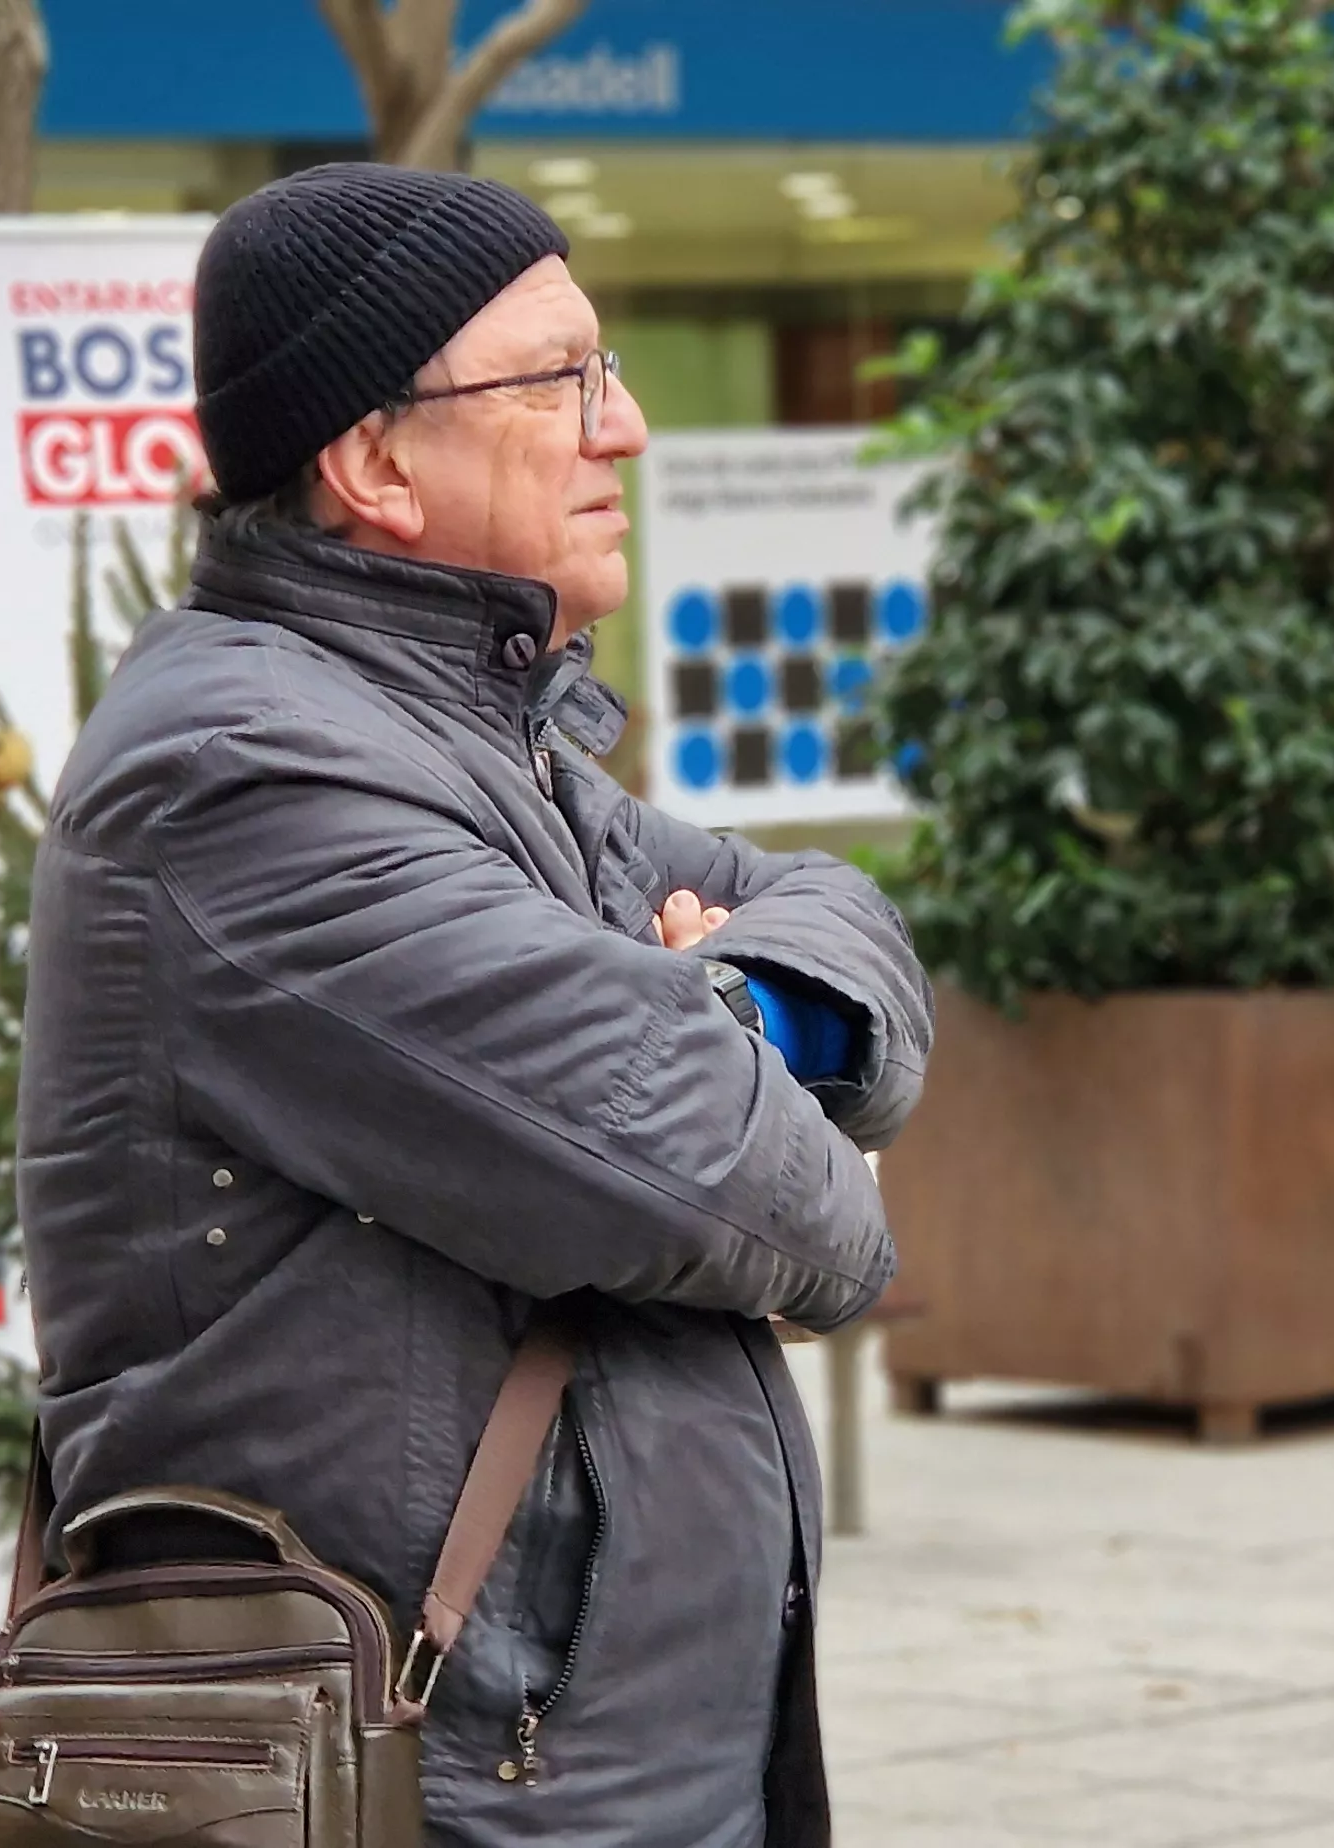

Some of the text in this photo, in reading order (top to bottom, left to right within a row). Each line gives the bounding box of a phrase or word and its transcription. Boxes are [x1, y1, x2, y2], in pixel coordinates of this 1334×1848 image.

[8, 278, 194, 316] ENTARAC
[18, 326, 191, 401] BOS
[29, 417, 202, 501] GLO
